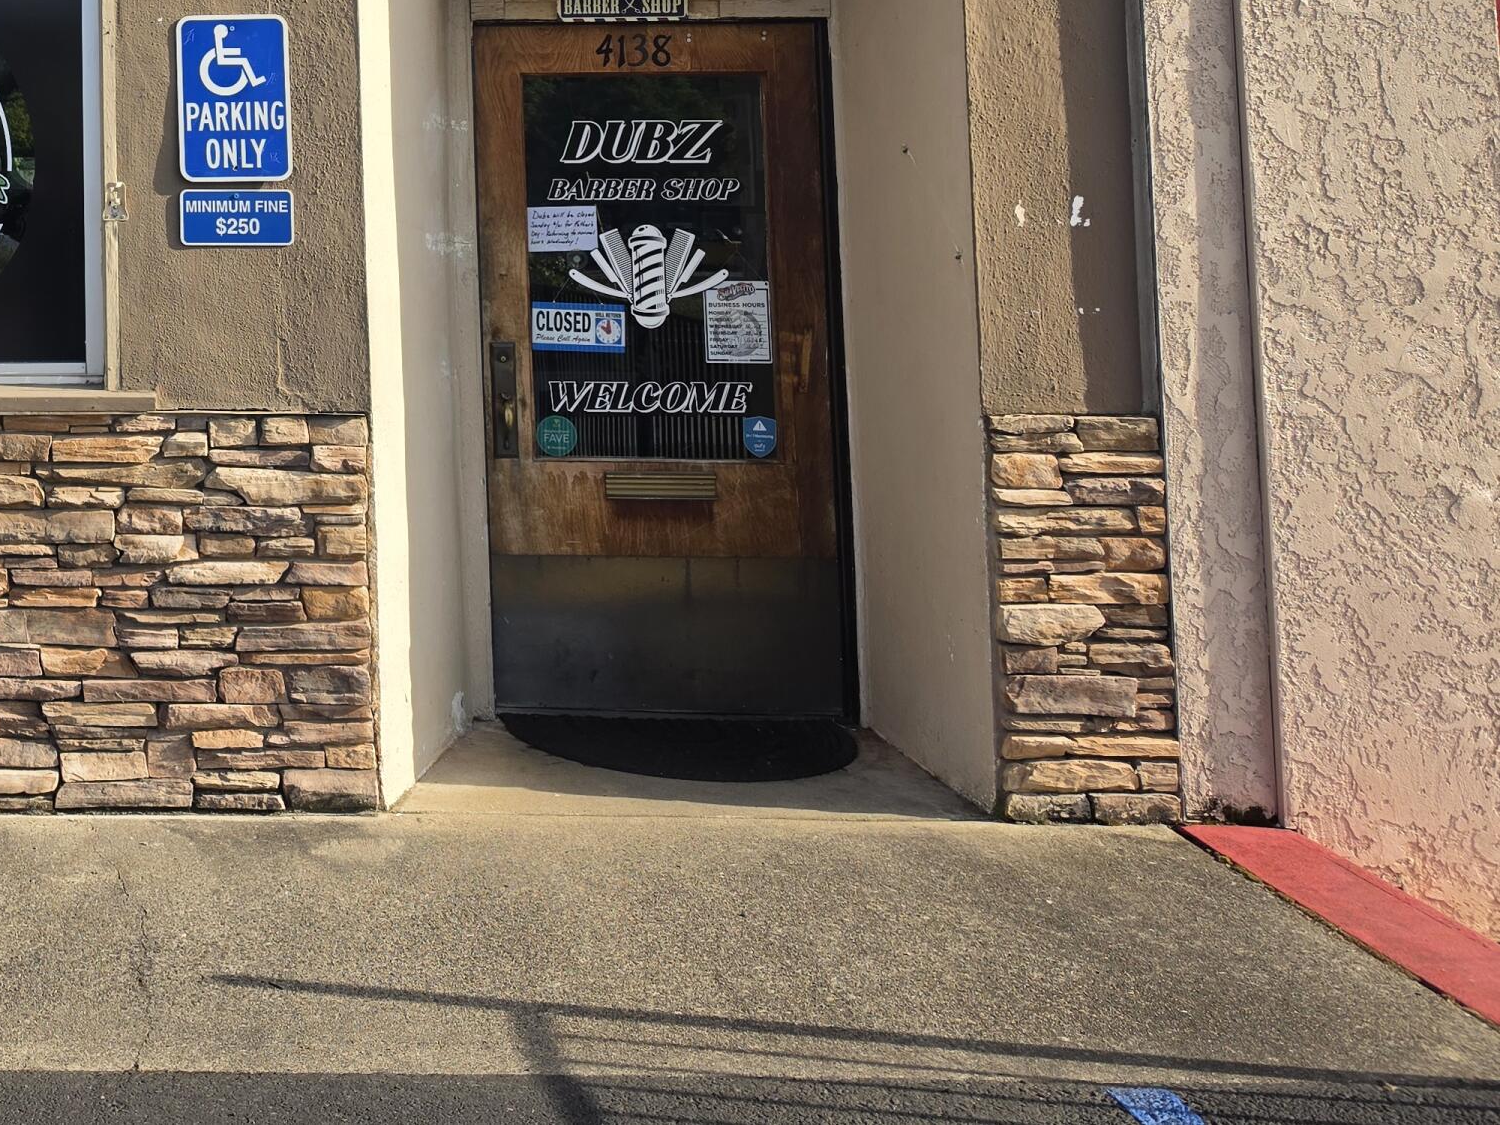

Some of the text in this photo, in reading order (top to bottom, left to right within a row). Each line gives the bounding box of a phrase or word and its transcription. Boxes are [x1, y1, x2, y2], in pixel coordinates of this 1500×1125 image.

[595, 33, 672, 68] 4138
[185, 100, 284, 132] PARKING
[205, 138, 267, 169] ONLY
[559, 120, 723, 164] DUBZ
[547, 178, 741, 201] BARBER SHOP
[185, 200, 289, 214] MINIMUM FINE
[215, 217, 260, 236] $250
[536, 310, 591, 333] CLOSED
[548, 381, 753, 413] WELCOME
[543, 433, 570, 444] FAVE
